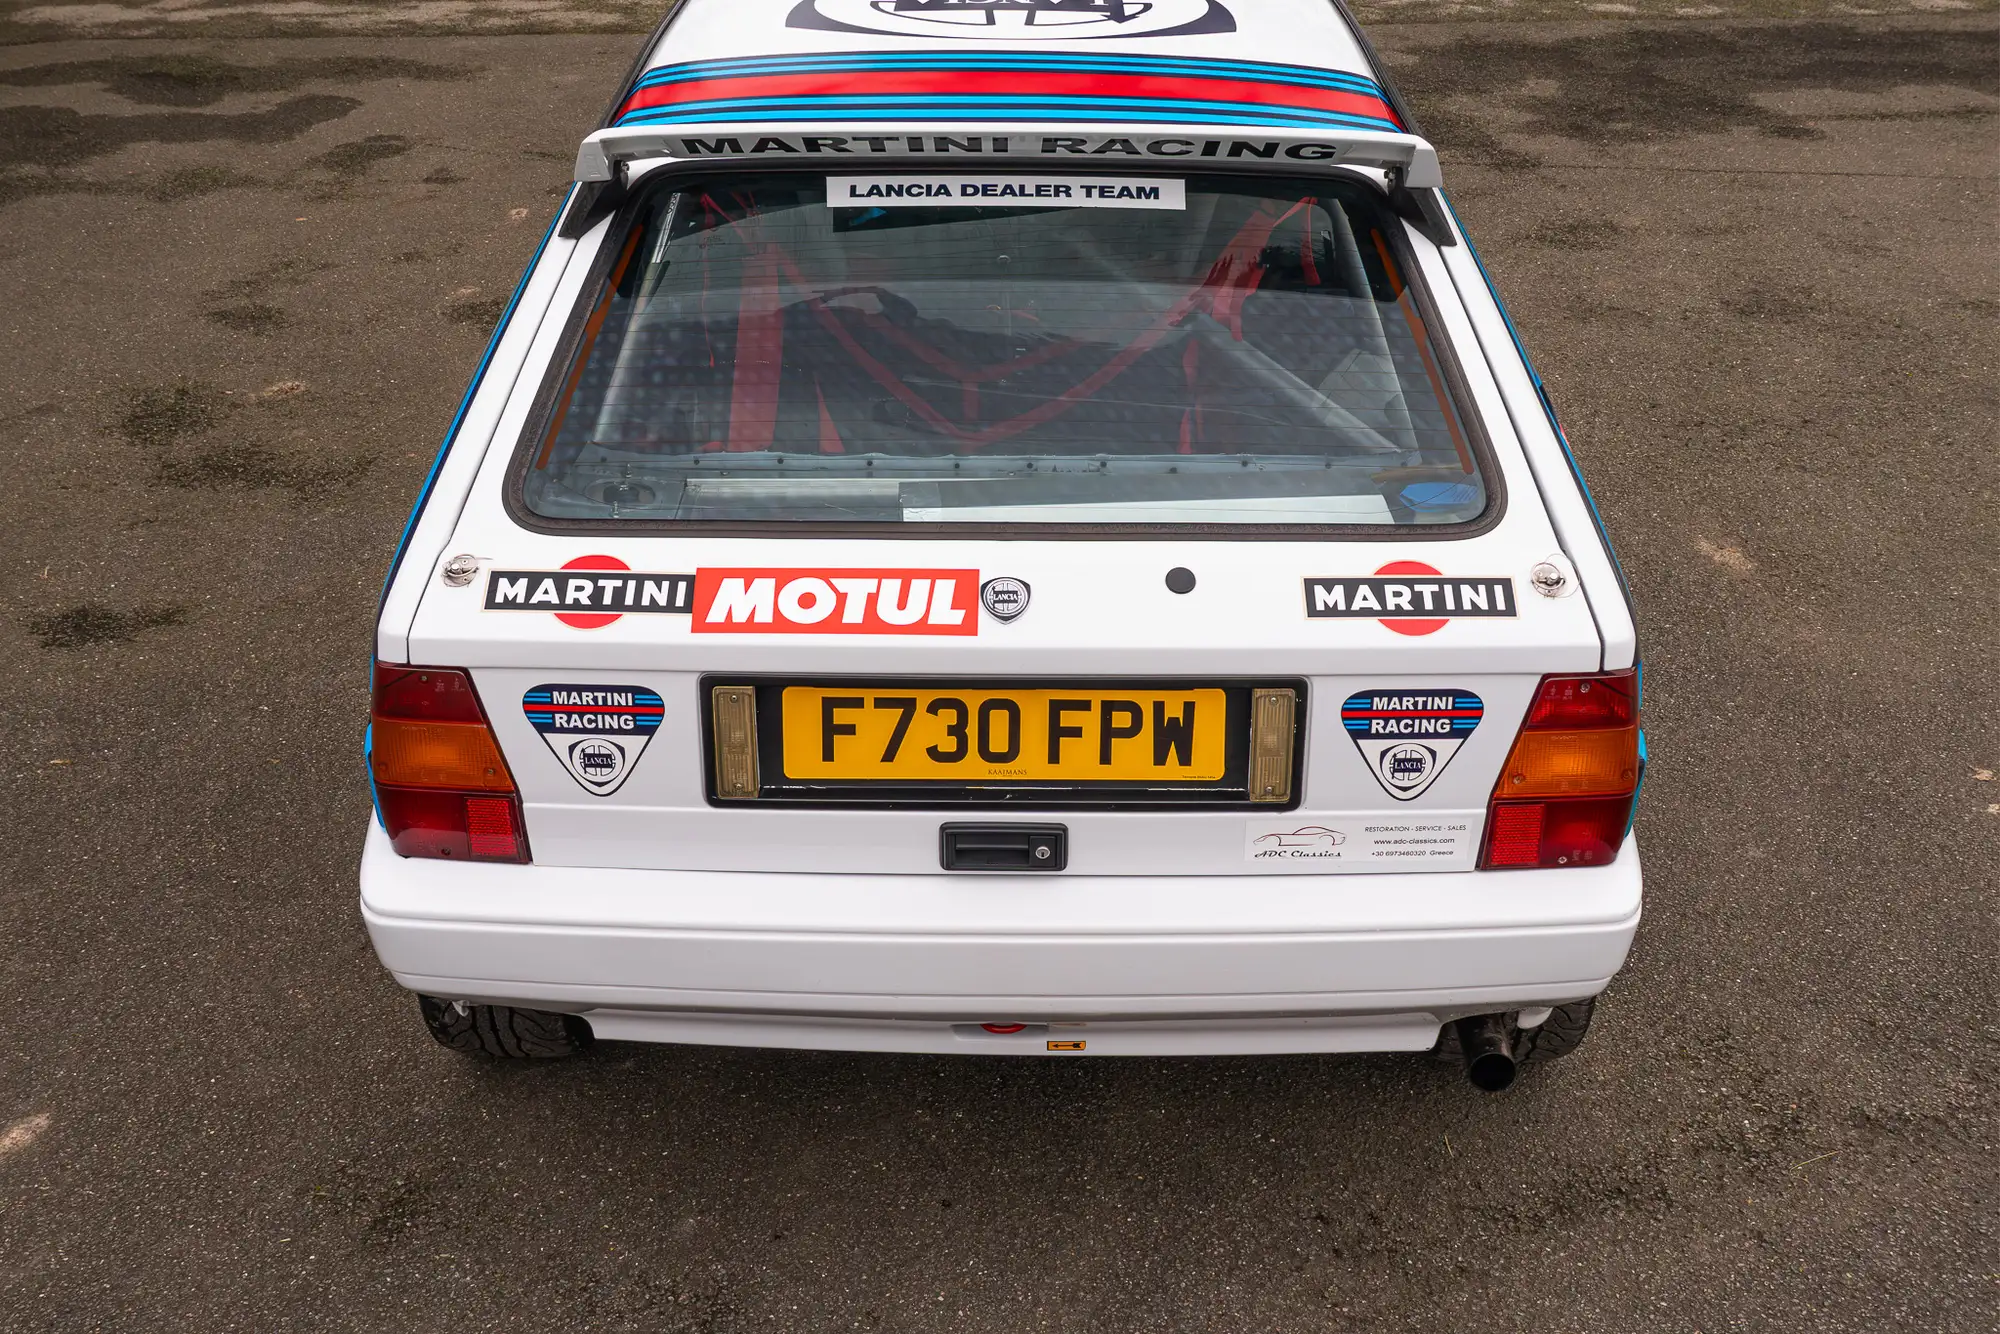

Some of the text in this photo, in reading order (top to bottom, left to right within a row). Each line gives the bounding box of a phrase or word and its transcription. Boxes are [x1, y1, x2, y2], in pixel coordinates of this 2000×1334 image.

[680, 137, 1337, 160] MARTINI RACING
[849, 184, 1160, 200] LANCIA DEALER TEAM
[498, 577, 686, 607] MARTINI
[1313, 582, 1507, 612] MARTINI
[704, 577, 967, 626] MOTUL
[552, 691, 634, 706] MARTINI
[1372, 696, 1453, 710] MARTINI
[554, 713, 635, 730] RACING
[1371, 718, 1451, 734] RACING
[821, 696, 1196, 767] F730 FPW
[585, 757, 612, 765] LANCIA
[1394, 761, 1421, 769] LANCIA
[1373, 837, 1455, 845] www.adc-classics.com
[1254, 850, 1342, 858] ADC Classics
